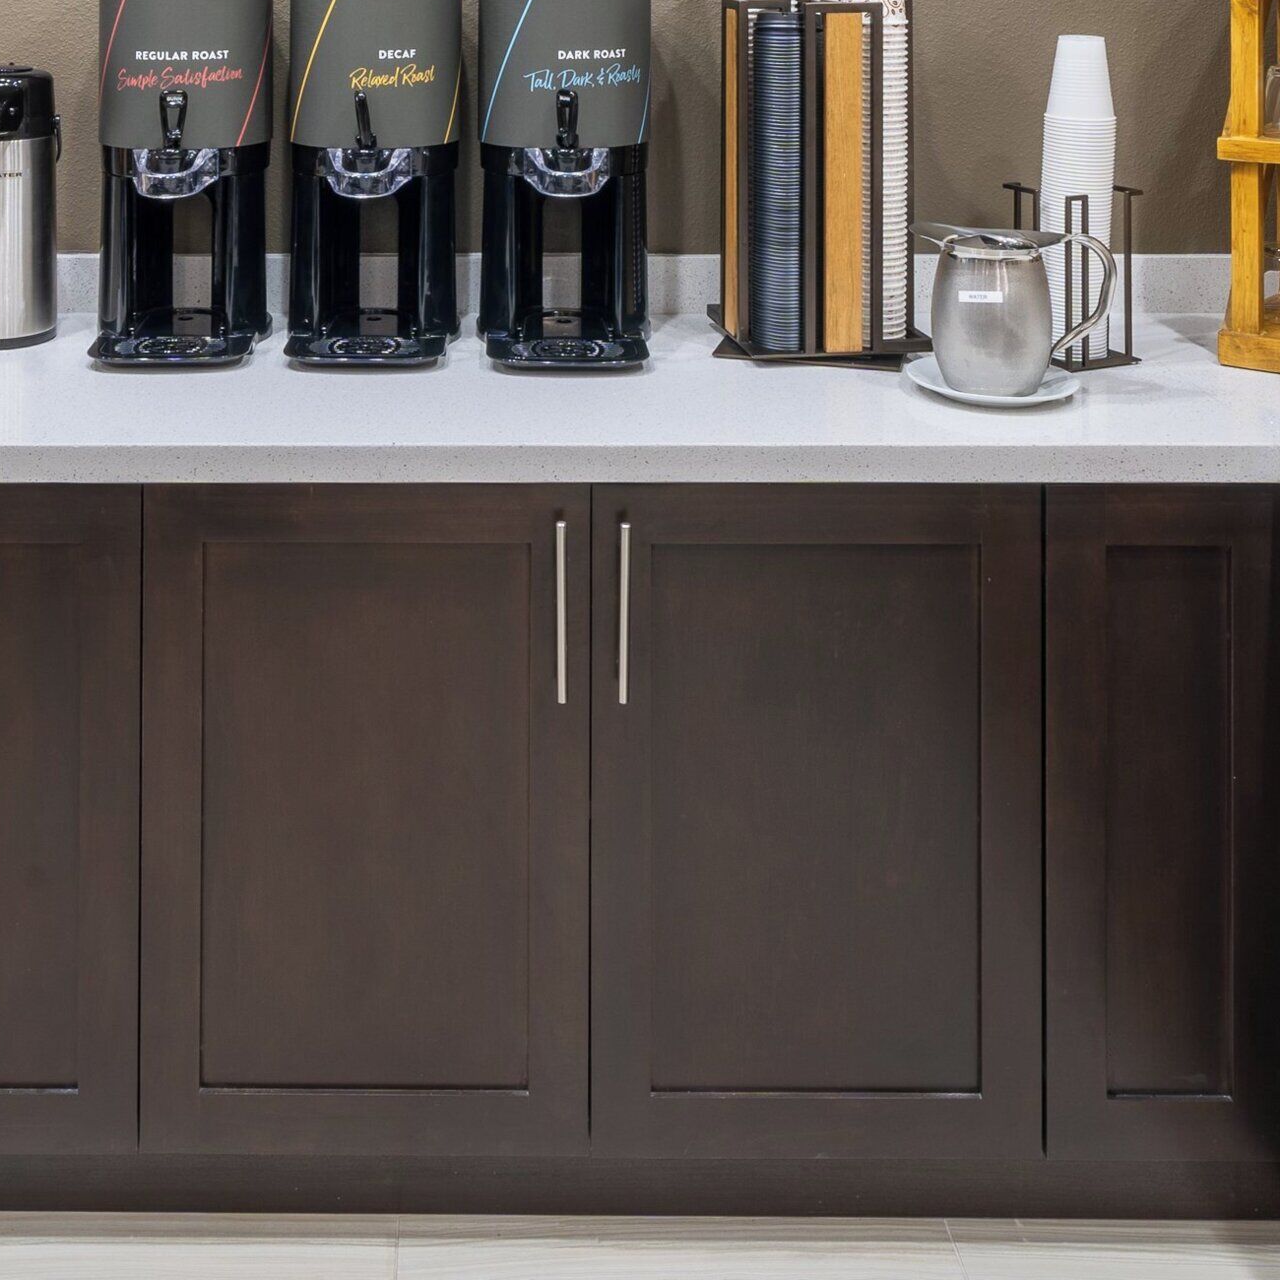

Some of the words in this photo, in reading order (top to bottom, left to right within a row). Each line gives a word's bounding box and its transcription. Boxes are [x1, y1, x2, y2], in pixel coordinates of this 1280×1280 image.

[135, 51, 188, 61] REGULAR
[192, 50, 230, 60] ROAST
[378, 49, 417, 59] DECAF
[558, 50, 590, 60] DARK
[594, 49, 627, 59] ROAST
[117, 68, 159, 91] Simple
[160, 66, 243, 89] Satisfaction
[349, 67, 400, 91] Relaxed
[400, 63, 435, 87] Roast
[597, 67, 605, 86] &
[606, 63, 641, 87] Roasty
